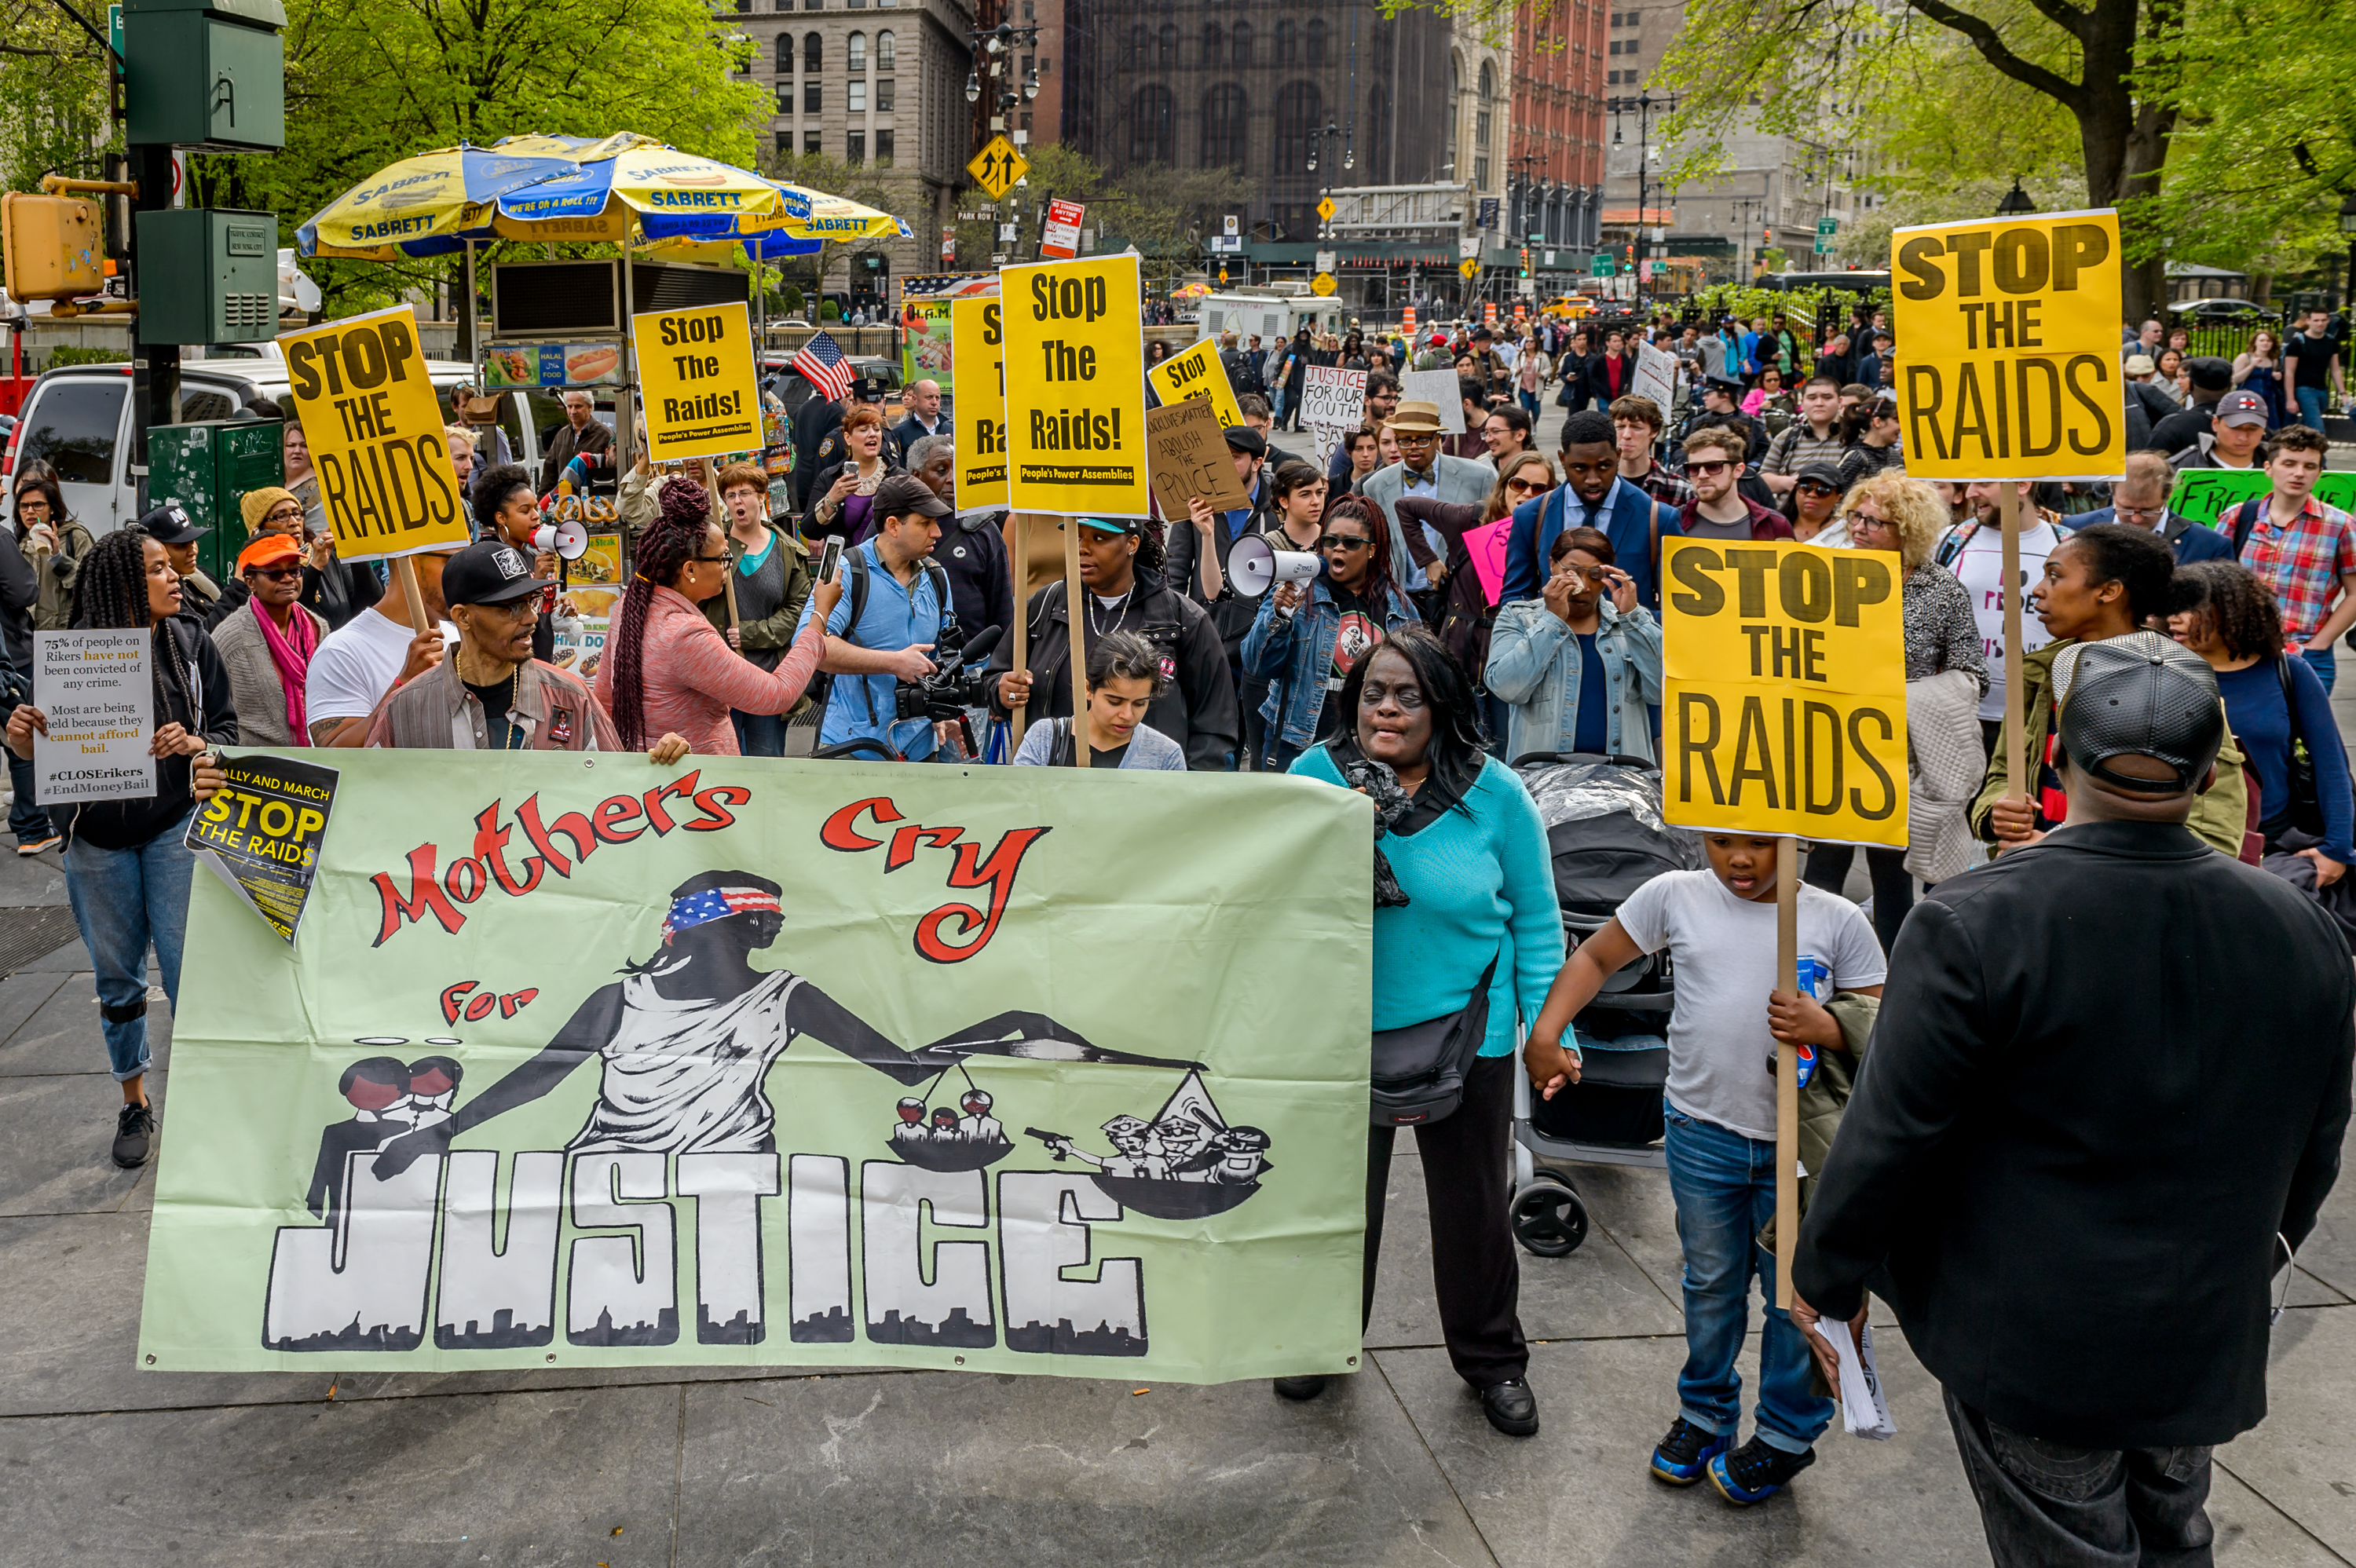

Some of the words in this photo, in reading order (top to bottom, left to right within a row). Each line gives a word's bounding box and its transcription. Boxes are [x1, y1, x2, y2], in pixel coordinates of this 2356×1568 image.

[627, 165, 712, 181] SABRETT
[352, 170, 451, 207] SABRETT
[650, 191, 741, 207] SABRETT
[508, 202, 536, 214] WE'RE
[538, 200, 550, 210] ON
[561, 197, 583, 207] ROLL
[1055, 208, 1077, 218] ANYTIME
[1060, 203, 1081, 213] STANDING
[351, 214, 436, 241] SABRETT
[805, 218, 869, 232] SABRETT
[1046, 221, 1056, 232] NO
[1899, 224, 2109, 301] STOP
[1031, 273, 1107, 323] Stop
[659, 316, 724, 346] Stop
[1959, 299, 2042, 349] THE
[288, 320, 412, 400] STOP
[673, 355, 719, 381] The
[1041, 339, 1096, 382] The
[1165, 353, 1206, 389] Stop
[1305, 365, 1366, 389] JUSTICE
[1305, 384, 1332, 403] FOR
[1335, 387, 1363, 404] OUR
[334, 391, 397, 442] THE
[664, 390, 741, 423] Raids!
[1304, 398, 1359, 418] YOUTH
[1907, 354, 2111, 460] RAIDS
[659, 432, 688, 442] People's
[689, 429, 711, 438] Power
[712, 424, 751, 435] Assemblies
[1030, 408, 1122, 450] Raids!
[1158, 430, 1203, 459] ABOLISH
[1175, 453, 1196, 467] THE
[968, 468, 998, 481] People's
[1022, 467, 1053, 480] People's
[1054, 469, 1080, 480] Power
[1081, 469, 1133, 481] Assemblies
[1156, 462, 1229, 503] POLICE
[318, 433, 455, 540] RAIDS
[596, 537, 616, 546] Steak
[1670, 546, 1891, 627] STOP
[44, 638, 69, 650] 75%
[72, 637, 84, 647] of
[86, 636, 123, 649] people
[584, 636, 605, 648] DO
[1741, 625, 1827, 683] THE
[46, 651, 81, 662] Rikers
[84, 650, 114, 660] have
[118, 649, 139, 660] not
[45, 664, 70, 675] been
[73, 663, 126, 674] convicted
[130, 663, 142, 672] of
[63, 680, 83, 690] any
[86, 677, 122, 688] crime.
[51, 704, 80, 715] Most
[83, 705, 101, 714] are
[104, 703, 136, 714] being
[71, 716, 116, 728] because
[119, 715, 144, 727] they
[49, 731, 95, 742] cannot
[98, 728, 139, 740] afford
[81, 744, 109, 754] bail.
[1678, 692, 1897, 821] RAIDS
[49, 767, 144, 781] #CLOSErikers
[223, 768, 251, 783] ALLY
[251, 774, 280, 790] AND
[284, 781, 330, 801] MARCH
[43, 778, 149, 795] #EndMoneyBail
[203, 788, 324, 842] STOP
[199, 820, 243, 849] THE
[247, 835, 314, 866] RAIDS
[370, 769, 752, 948] Mothers
[819, 796, 1052, 964] Cry
[261, 1150, 1149, 1357] JUSTICE
